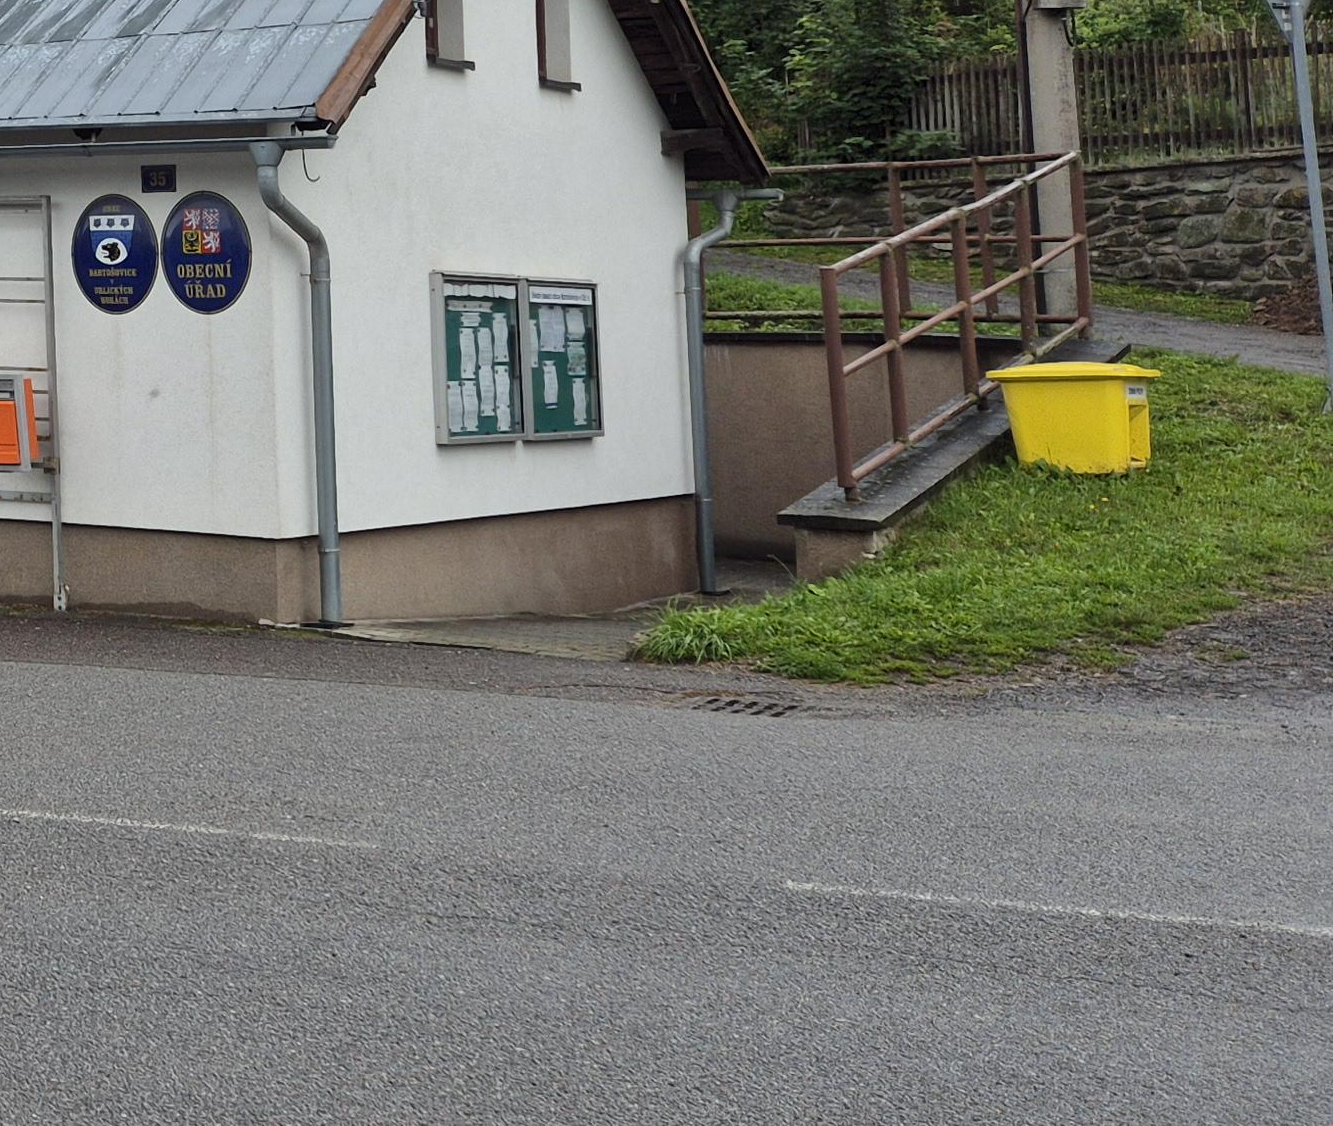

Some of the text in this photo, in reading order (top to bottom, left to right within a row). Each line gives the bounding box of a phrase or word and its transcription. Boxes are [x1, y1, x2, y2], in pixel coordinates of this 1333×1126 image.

[149, 172, 166, 187] 35
[177, 259, 232, 278] OBECNÍ
[185, 281, 226, 298] ÚŘAD
